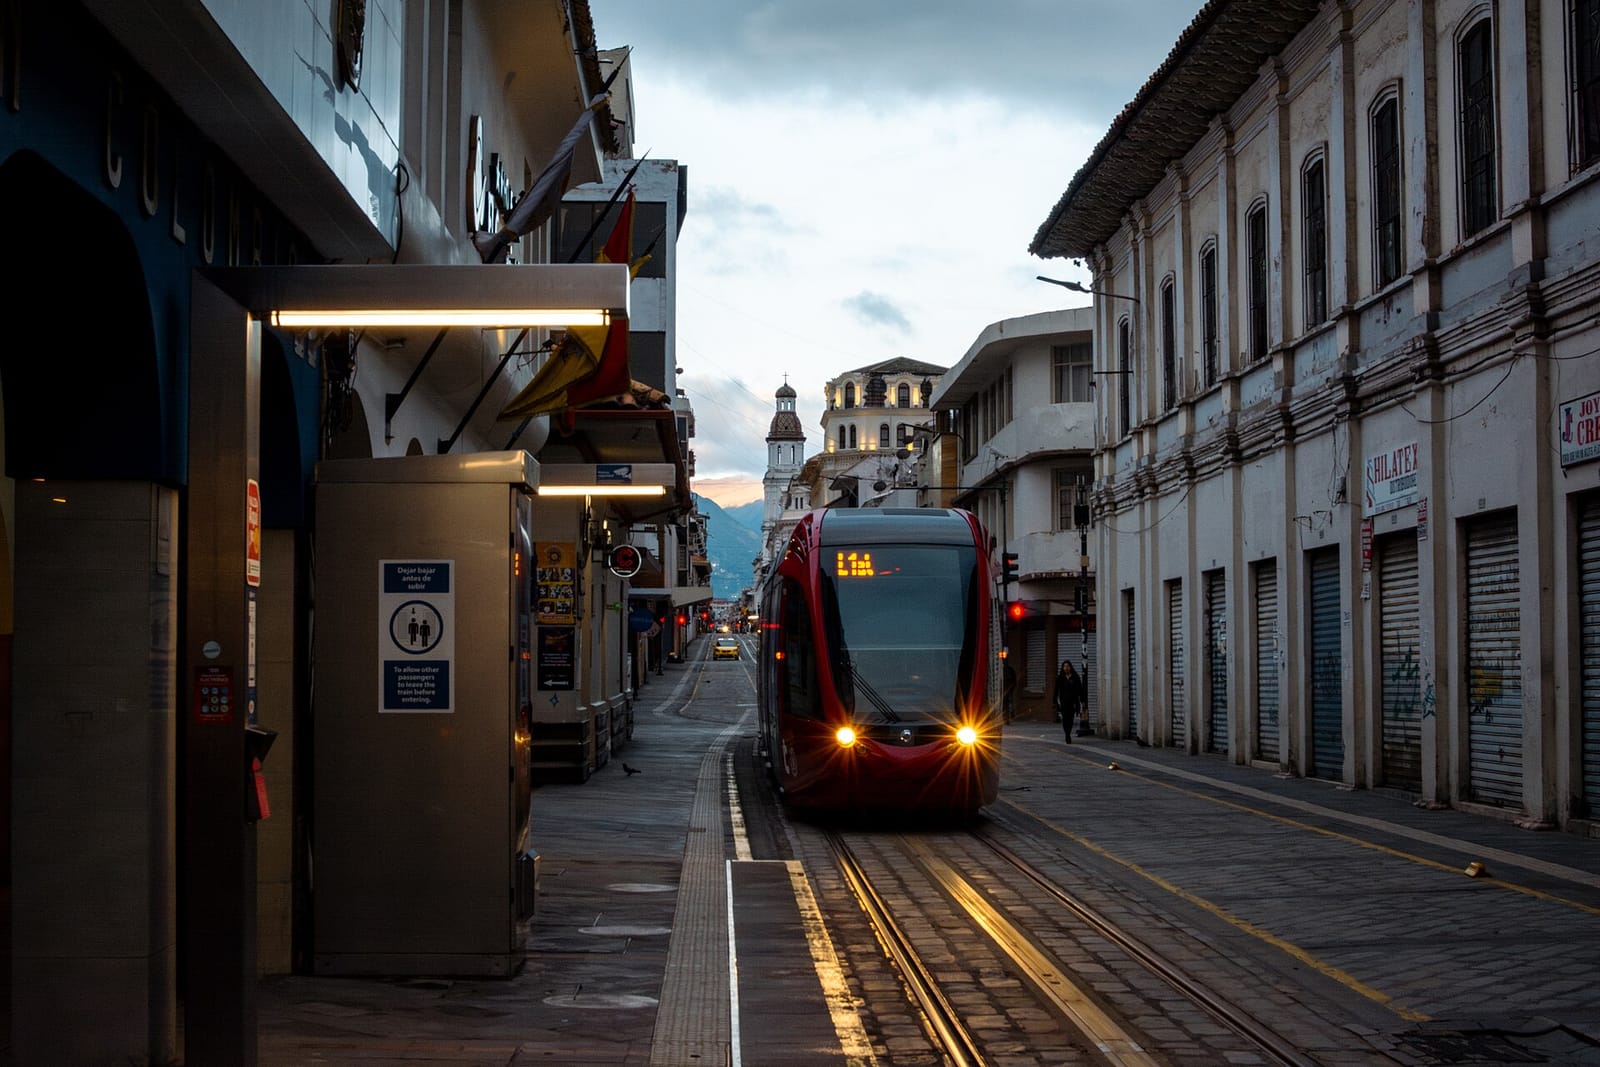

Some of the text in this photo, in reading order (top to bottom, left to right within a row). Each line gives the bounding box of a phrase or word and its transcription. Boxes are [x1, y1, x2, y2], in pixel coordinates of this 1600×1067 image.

[397, 567, 436, 576] Dejar bajar
[407, 582, 426, 590] subir
[393, 665, 439, 673] To allow other
[397, 674, 435, 682] passengers
[397, 688, 435, 696] train before
